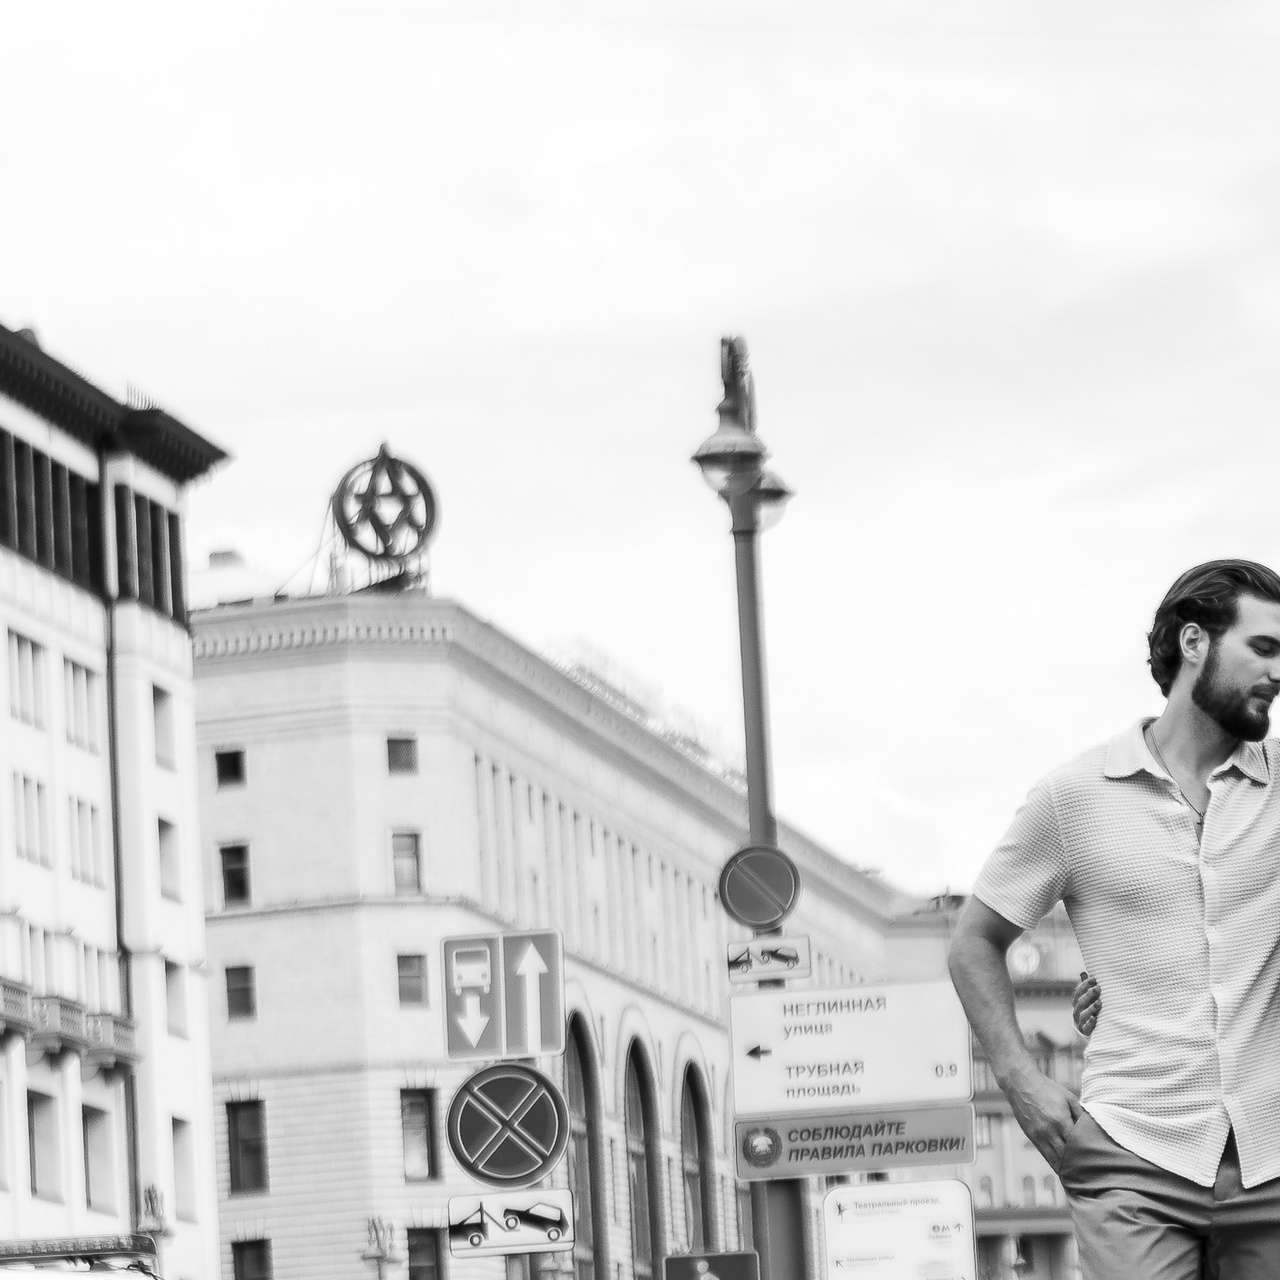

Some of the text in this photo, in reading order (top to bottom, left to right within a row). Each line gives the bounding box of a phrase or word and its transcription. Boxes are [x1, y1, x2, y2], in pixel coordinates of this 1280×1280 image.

[783, 997, 887, 1017] НЕГЛИННАЯ
[784, 1023, 833, 1040] улица
[785, 1060, 865, 1079] ТРУБНАЯ
[786, 1083, 861, 1098] площадь
[788, 1120, 907, 1142] СОБЛЮДАЙТЕ
[788, 1137, 966, 1162] ПРАВИЛА ПАРКОВКИ!
[854, 1197, 940, 1210] Театральный проезд
